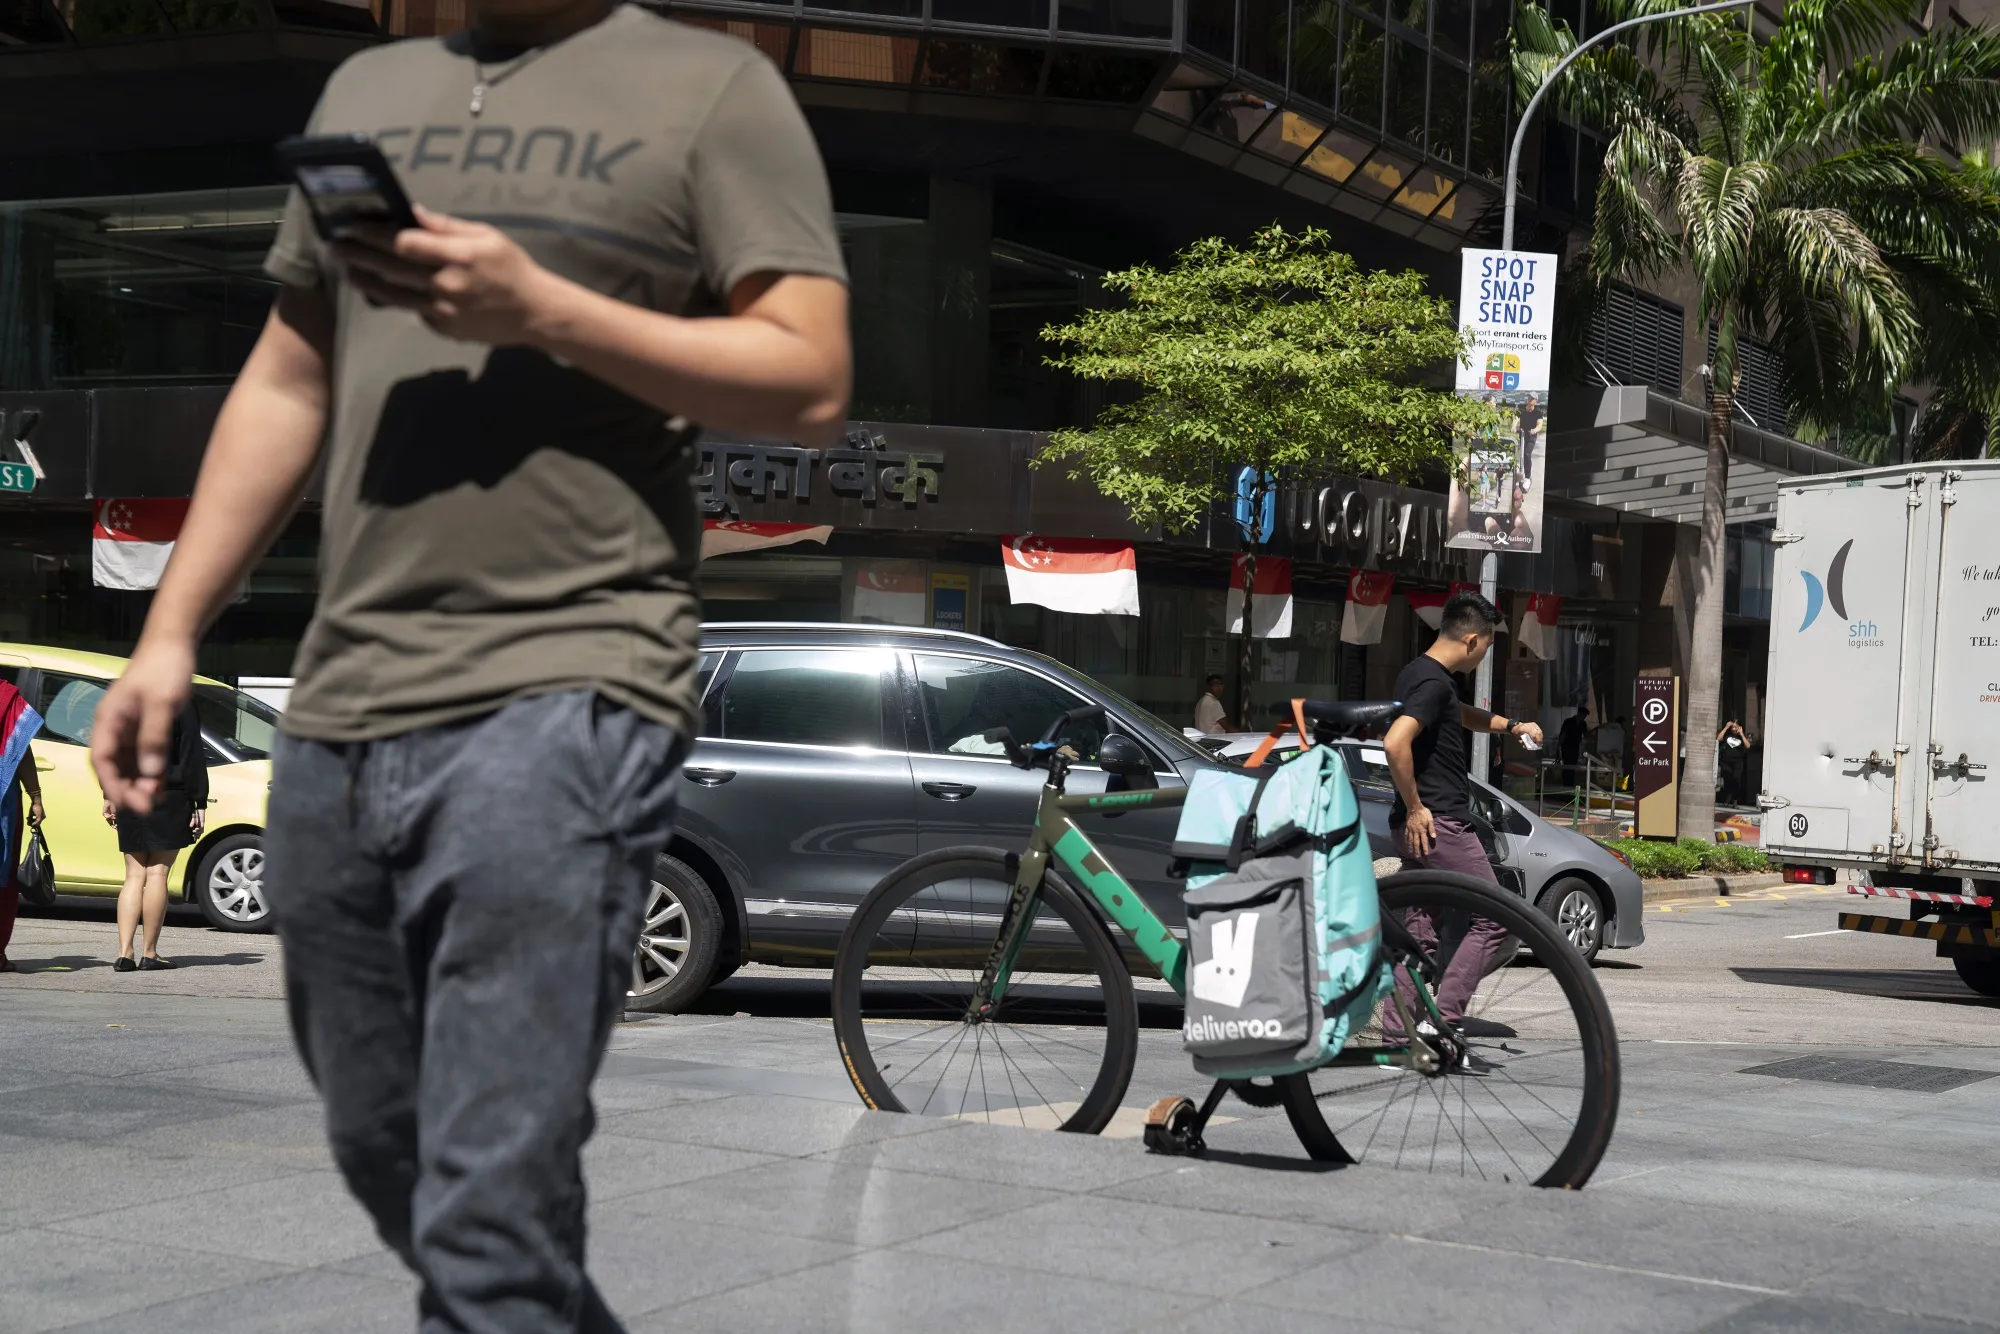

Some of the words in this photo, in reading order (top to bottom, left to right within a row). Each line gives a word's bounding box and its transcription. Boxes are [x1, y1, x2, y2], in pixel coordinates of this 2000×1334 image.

[1481, 256, 1538, 280] SPOT
[1479, 279, 1535, 302] SNAP
[1478, 301, 1533, 325] SEND
[1462, 327, 1491, 338] Rport
[1493, 330, 1520, 339] errant
[1521, 331, 1547, 340] riders
[2, 466, 24, 488] St
[1374, 497, 1466, 565] BAN
[1507, 535, 1532, 543] Authority
[1962, 565, 1980, 581] We
[1849, 620, 1877, 637] shh
[1848, 639, 1885, 649] logistics
[1970, 636, 1998, 647] TEL:
[1988, 682, 2000, 692] CL
[1649, 703, 1663, 720] P
[1638, 757, 1651, 765] Car
[1653, 757, 1669, 766] Park
[1791, 816, 1806, 831] 60
